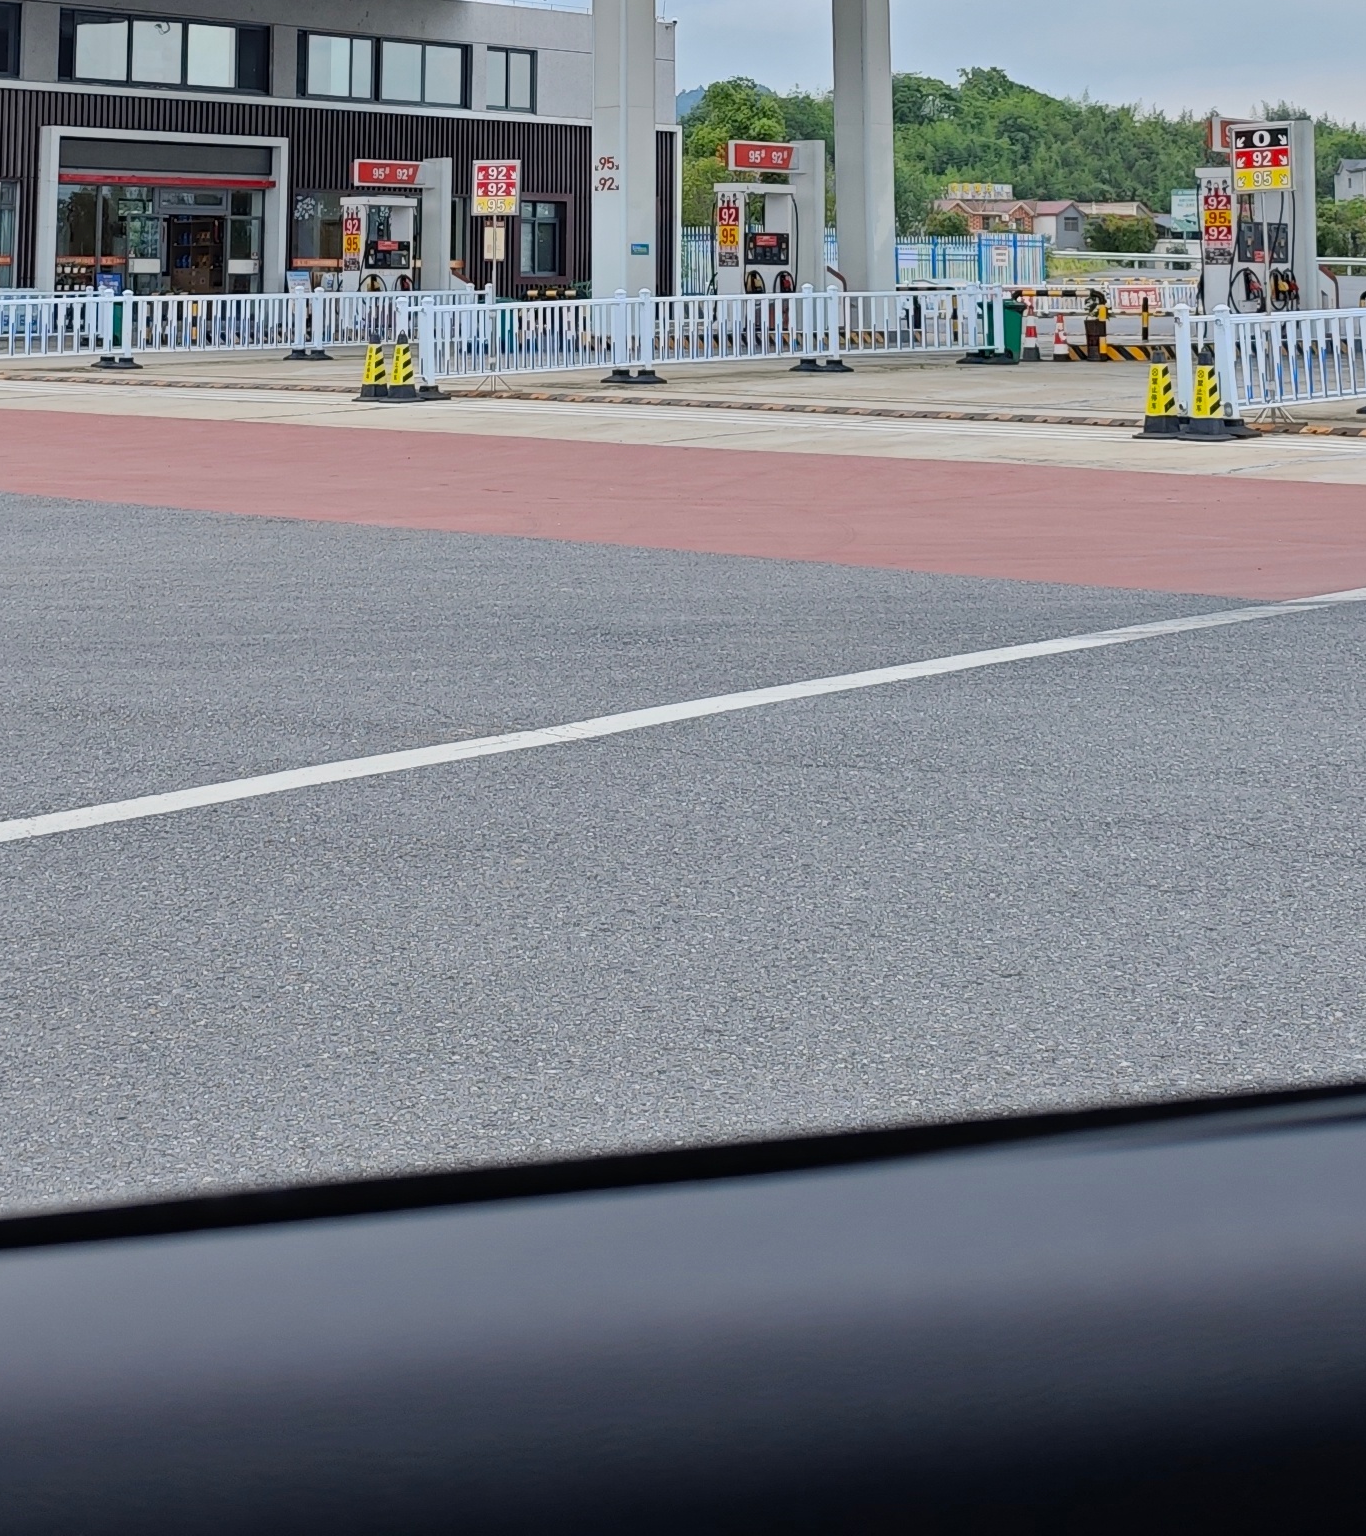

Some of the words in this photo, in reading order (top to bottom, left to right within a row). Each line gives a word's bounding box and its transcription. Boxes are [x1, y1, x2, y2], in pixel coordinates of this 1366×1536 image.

[1252, 130, 1271, 147] 0
[598, 156, 615, 171] 95
[1252, 151, 1272, 166] 92
[488, 166, 507, 179] 92
[1252, 171, 1273, 186] 95
[487, 182, 507, 195] 92
[598, 176, 615, 191] 92
[487, 199, 506, 212] 95
[1207, 196, 1228, 210] 92
[721, 208, 736, 225] 92
[1208, 211, 1227, 224] 95
[346, 219, 360, 234] 92
[1208, 226, 1228, 240] 92
[721, 227, 736, 244] 95
[346, 236, 359, 252] 95
